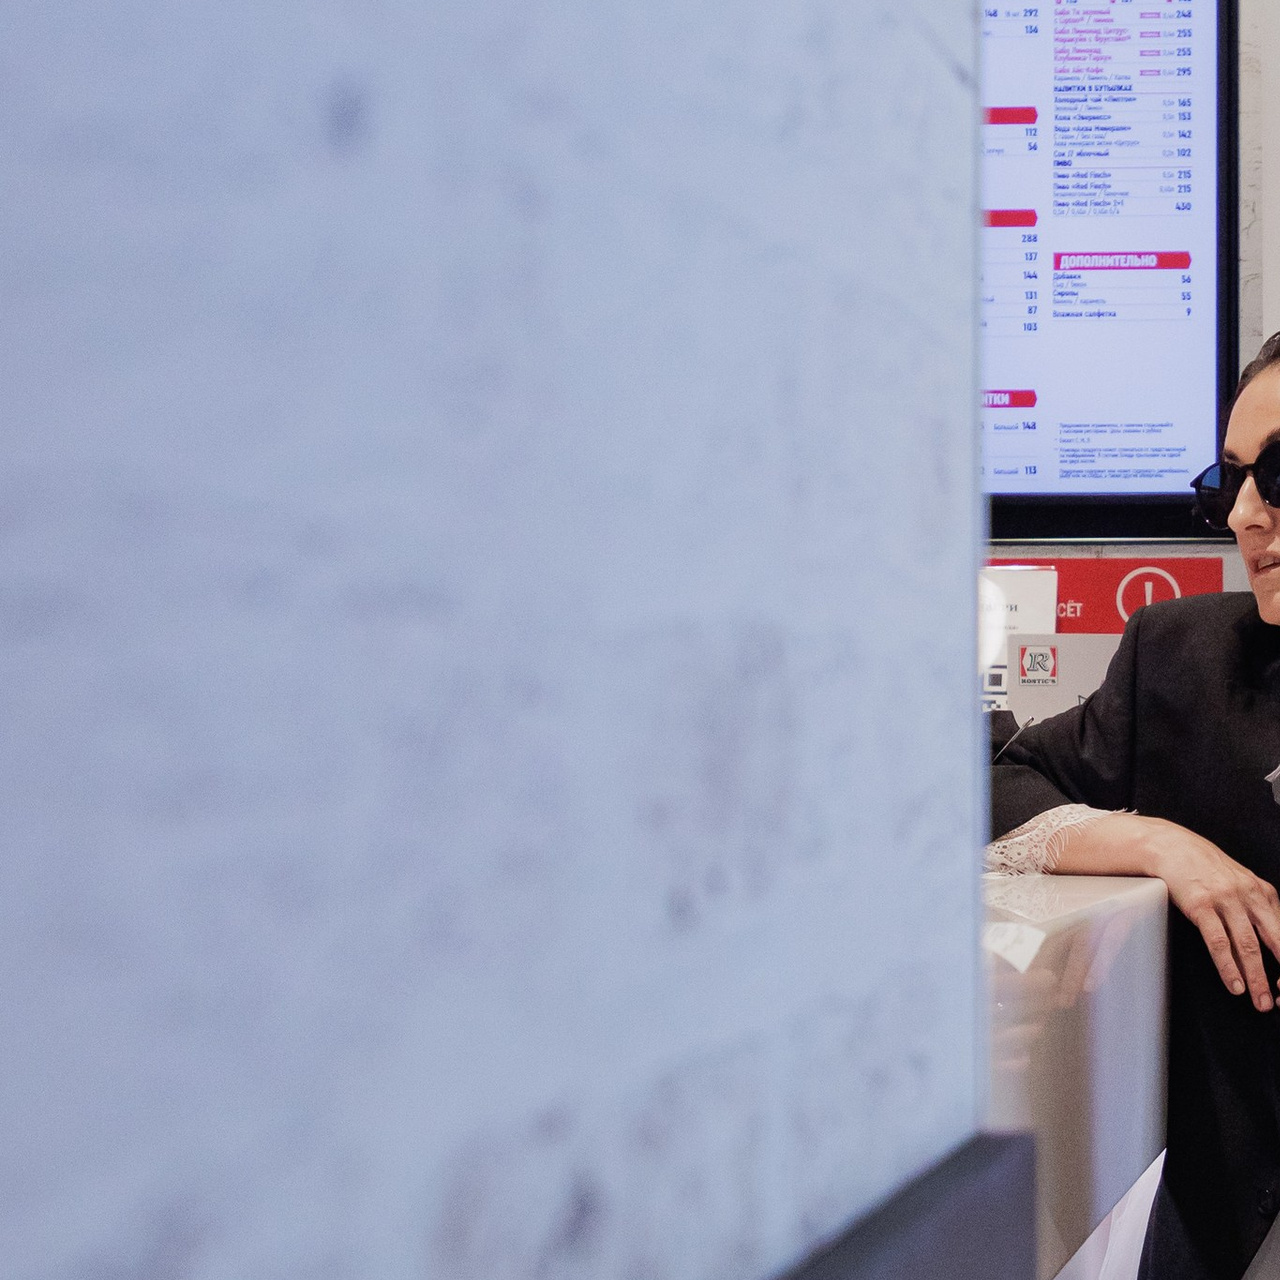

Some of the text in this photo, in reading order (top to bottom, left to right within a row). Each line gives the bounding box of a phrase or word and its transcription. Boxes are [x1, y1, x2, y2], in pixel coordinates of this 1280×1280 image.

[1177, 148, 1191, 157] 102
[1177, 170, 1192, 179] 215
[1177, 185, 1192, 193] 215
[1021, 234, 1038, 243] 288
[1060, 255, 1158, 270] ДОПОЛНИТЕЛЬНО
[1181, 291, 1191, 301] 55
[1027, 305, 1038, 315] 87
[1187, 307, 1191, 316] 9
[1023, 322, 1038, 331] 103
